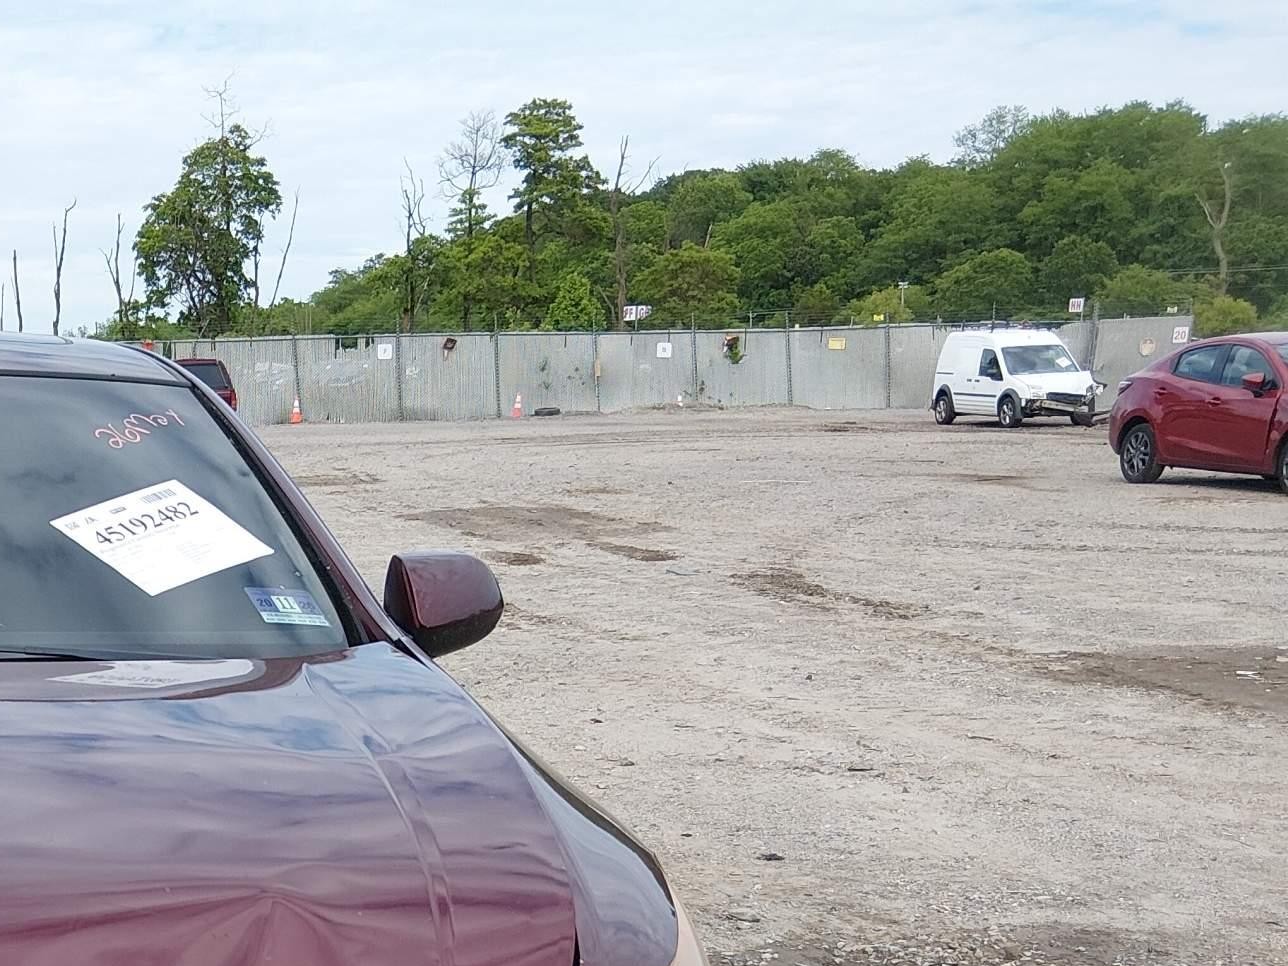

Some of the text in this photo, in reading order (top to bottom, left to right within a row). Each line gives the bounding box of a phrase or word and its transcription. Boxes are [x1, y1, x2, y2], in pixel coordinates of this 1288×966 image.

[1175, 330, 1186, 340] 20
[95, 502, 199, 544] 45192482
[276, 597, 297, 610] 11
